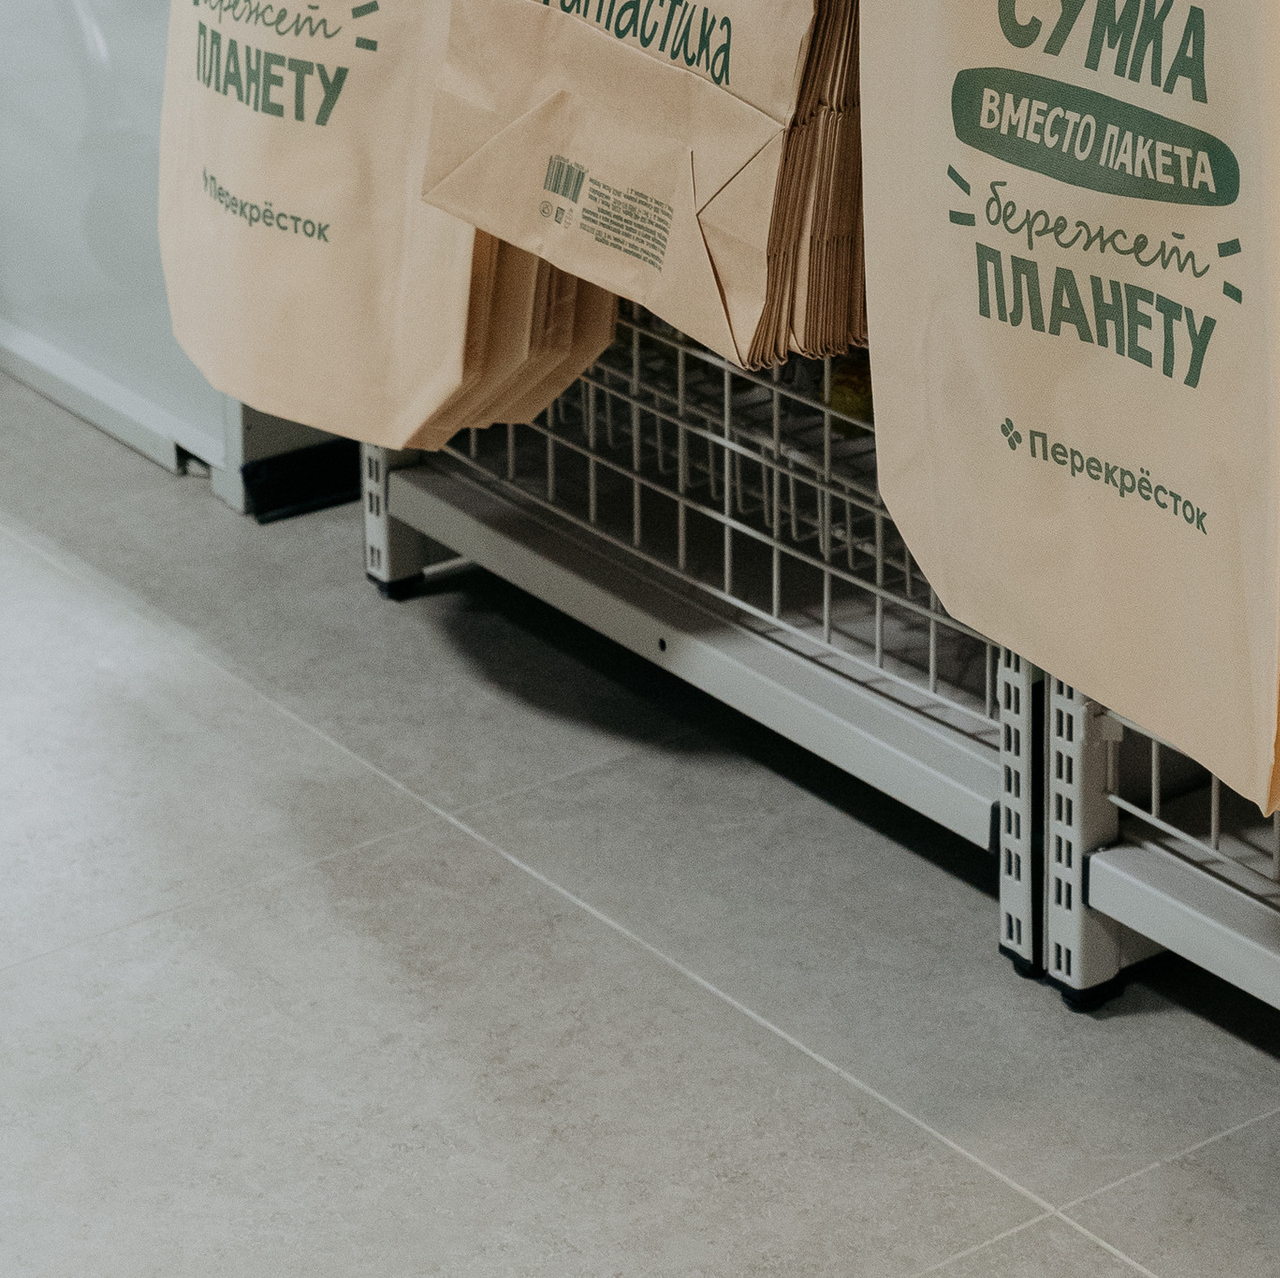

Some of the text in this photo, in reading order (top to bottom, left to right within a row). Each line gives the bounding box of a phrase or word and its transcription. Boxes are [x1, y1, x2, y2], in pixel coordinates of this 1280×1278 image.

[197, 21, 350, 127] ПЛАНЕТУ
[979, 87, 1217, 194] ВМЕСТО ПАКЕТА
[985, 180, 1211, 278] бережет
[975, 241, 1218, 390] ПЛАНЕТУ
[1028, 427, 1209, 536] Перекрёсток
